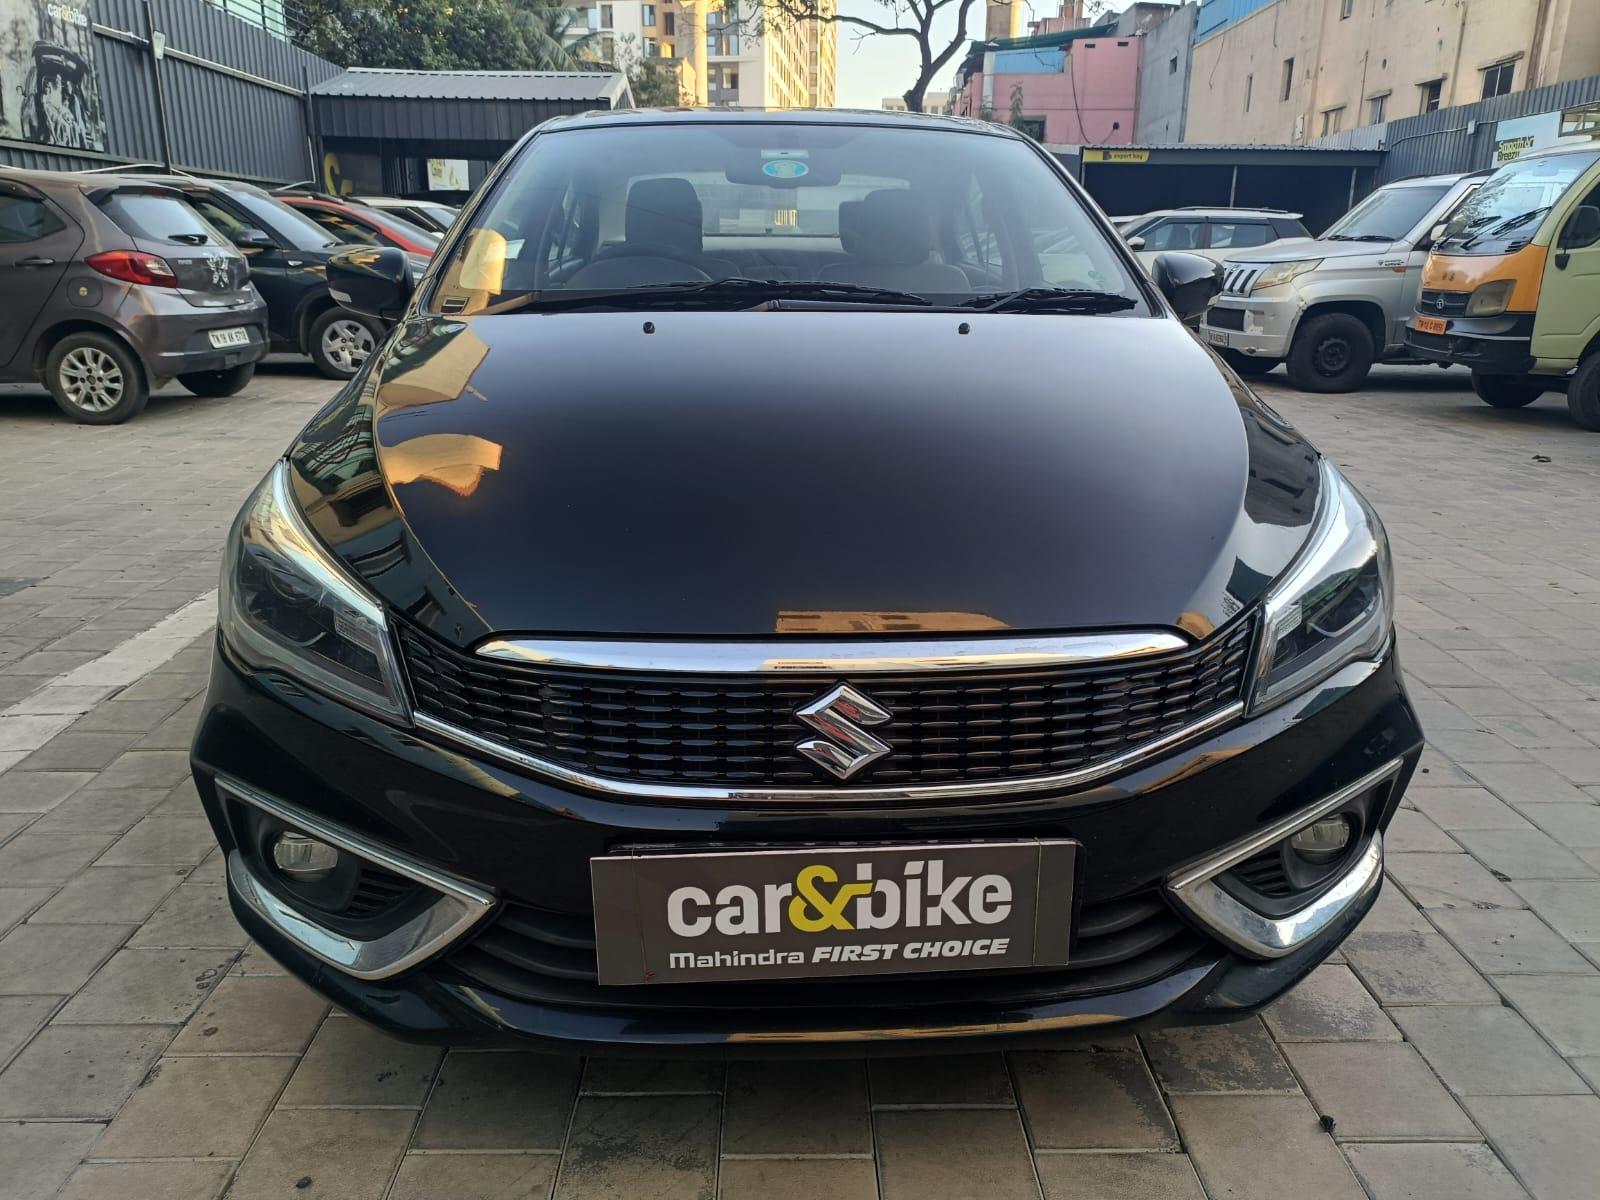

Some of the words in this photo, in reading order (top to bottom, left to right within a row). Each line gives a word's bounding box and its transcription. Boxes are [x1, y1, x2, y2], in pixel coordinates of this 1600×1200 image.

[667, 860, 1013, 938] car&bike
[669, 949, 805, 969] Mahindra
[811, 943, 899, 963] FIRST
[903, 938, 1010, 960] CHOICE
